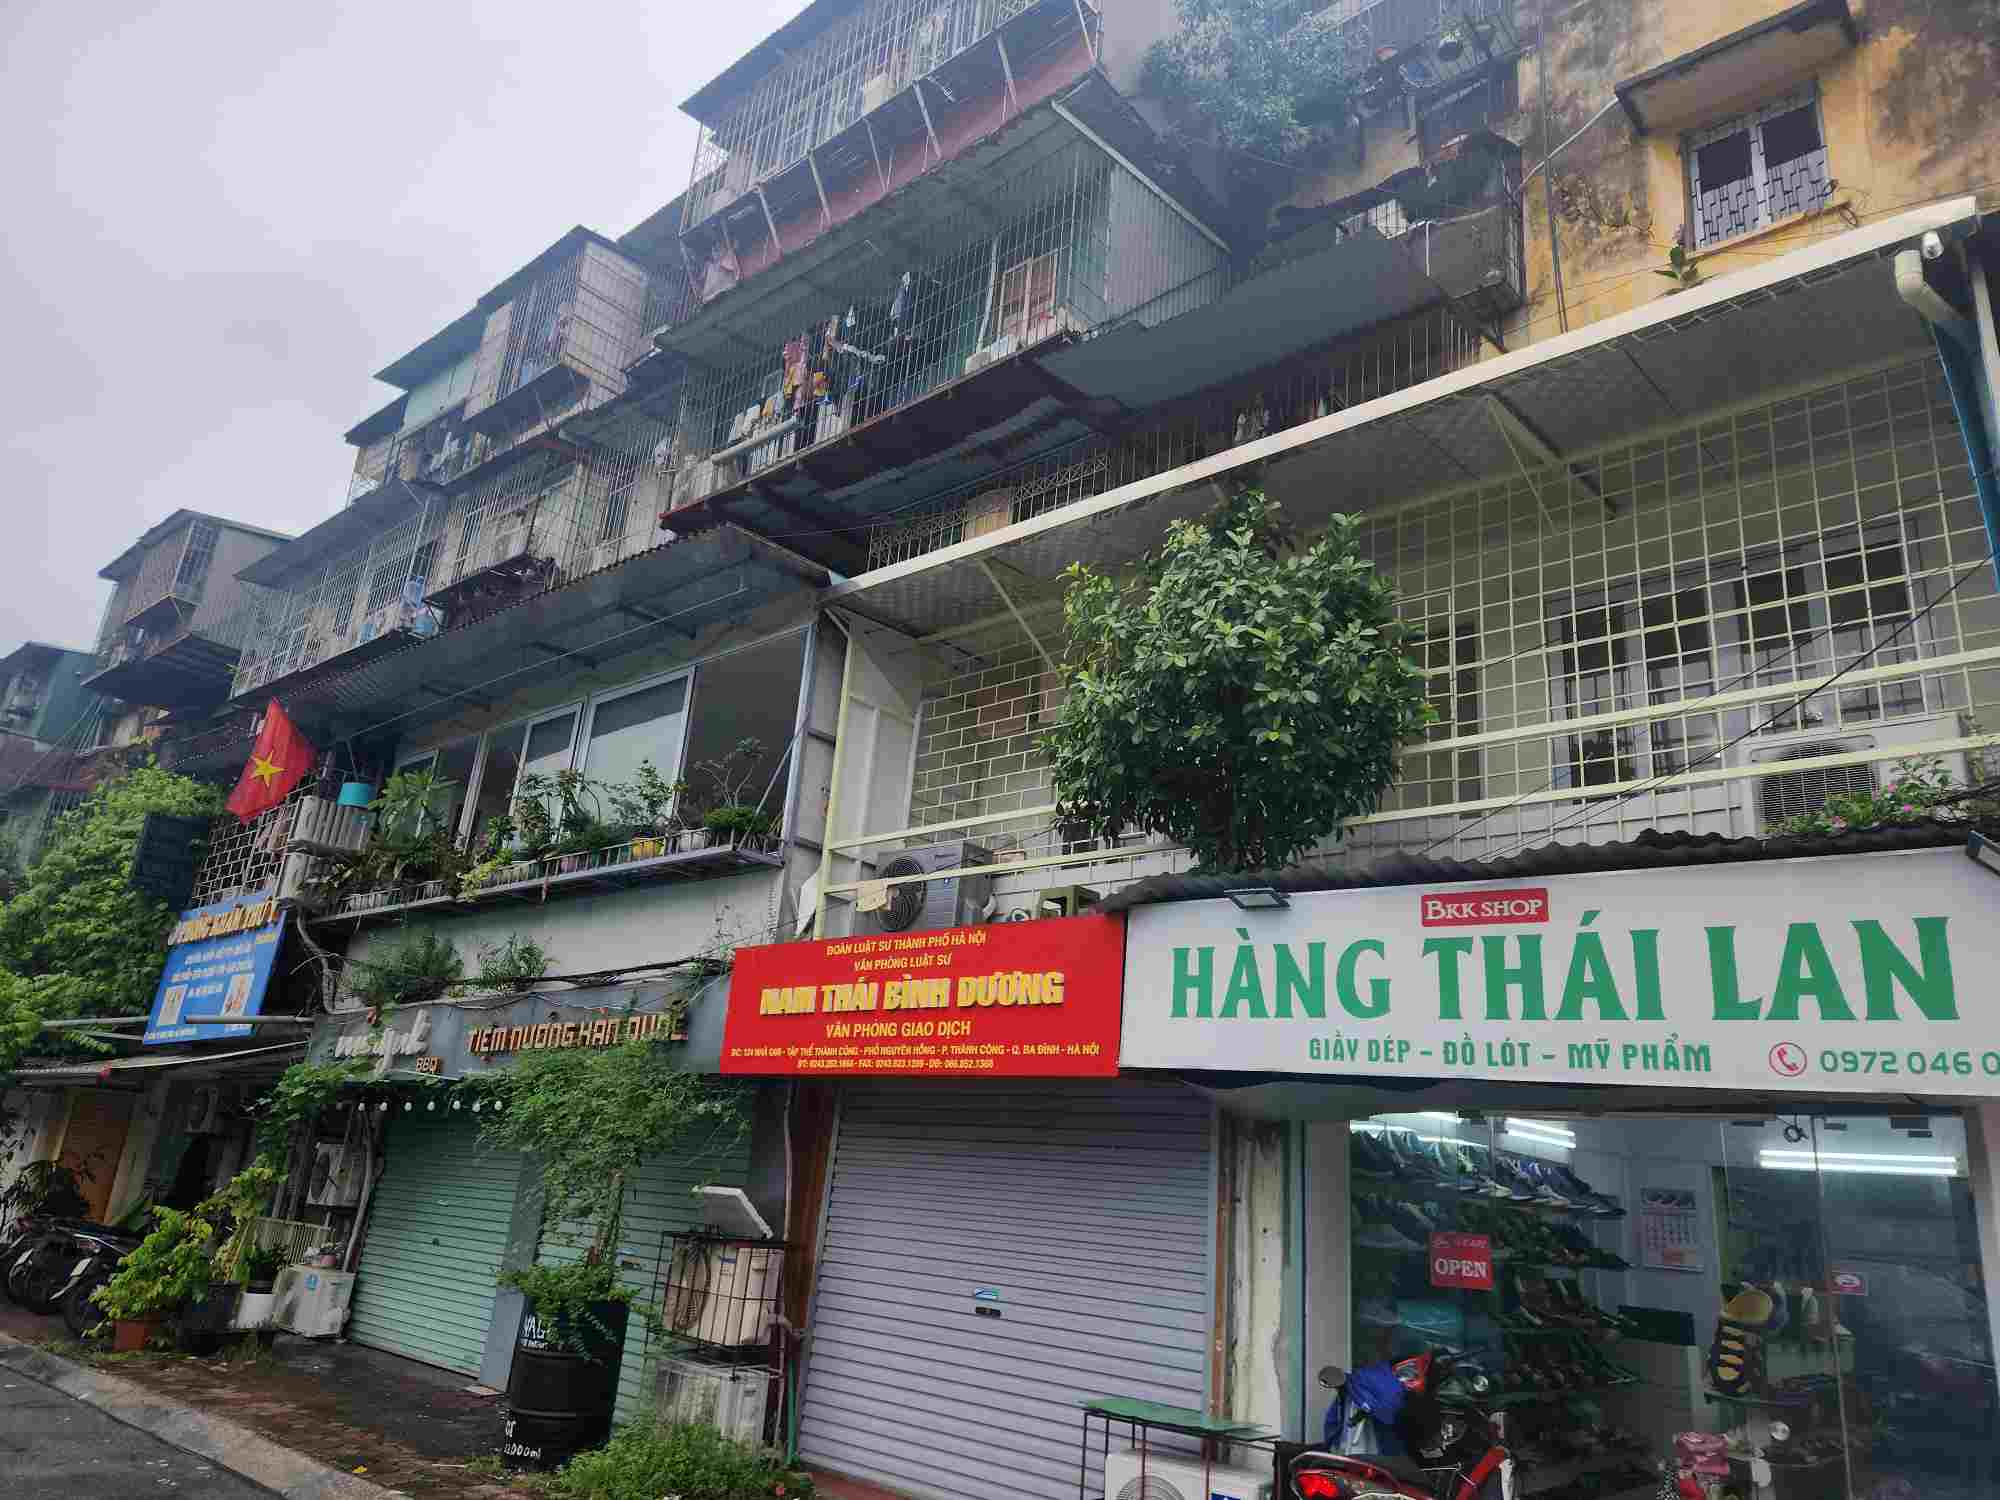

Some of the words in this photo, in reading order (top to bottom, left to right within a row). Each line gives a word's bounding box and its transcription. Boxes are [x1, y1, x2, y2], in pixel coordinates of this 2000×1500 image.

[1424, 899, 1479, 920] BKK
[1480, 898, 1543, 918] SHOP
[826, 942, 852, 956] ĐOÀN
[854, 938, 877, 954] LUẬT
[878, 939, 892, 952] SƯ
[893, 937, 928, 951] THÀNH
[927, 932, 950, 948] PHỐ
[951, 931, 966, 946] HÀ
[968, 930, 986, 947] NỘI
[854, 957, 873, 971] VĂN
[874, 956, 908, 970] PHÒNG
[910, 954, 934, 969] LUẬT
[936, 953, 952, 966] SƯ
[1168, 927, 1393, 1020] HÀNG
[1421, 910, 1667, 1022] THÁI
[1703, 916, 1961, 1021] LAN
[759, 985, 818, 1015] NAM
[821, 976, 879, 1013] THÁI
[882, 974, 952, 1010] BÌNH
[956, 970, 1065, 1008] DƯƠNG
[825, 1020, 850, 1038] VĂN
[853, 1018, 898, 1038] PHÒNG
[901, 1020, 934, 1037] GIAO
[937, 1019, 971, 1040] DỊCH
[979, 1042, 1005, 1055] CÔNG
[1023, 1044, 1036, 1055] BA
[1036, 1042, 1060, 1055] ĐÌNH
[1066, 1042, 1081, 1055] HÀ
[1367, 1033, 1411, 1063] DÉP
[1442, 1032, 1476, 1067] ĐỒ
[1485, 1036, 1532, 1068] LÓT
[1567, 1036, 1610, 1070] MỸ
[1621, 1031, 1712, 1073] PHẨM
[415, 1056, 442, 1074] BBQ
[1819, 1050, 1899, 1075] 0972
[1906, 1051, 1973, 1076] 046
[1434, 1258, 1488, 1279] OPEN
